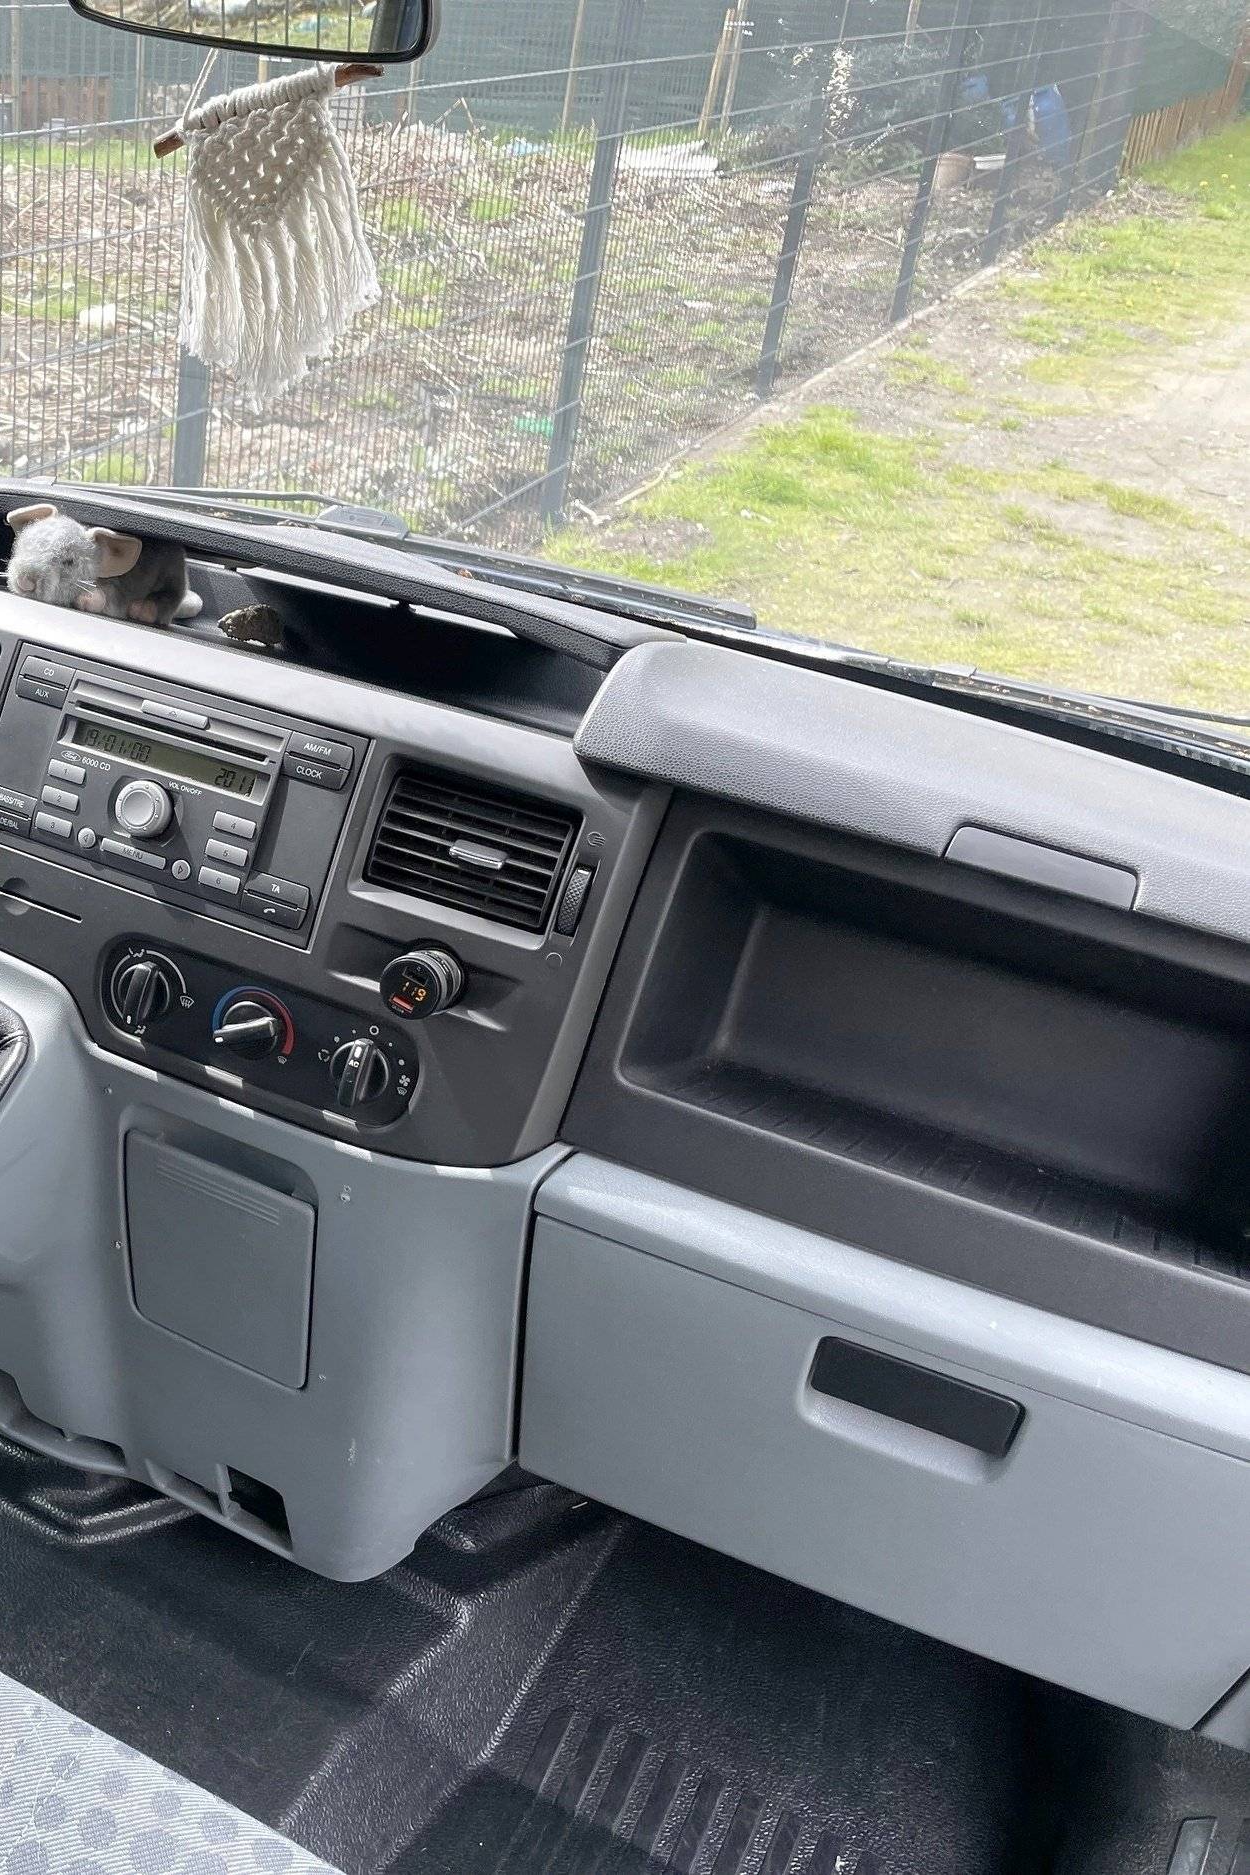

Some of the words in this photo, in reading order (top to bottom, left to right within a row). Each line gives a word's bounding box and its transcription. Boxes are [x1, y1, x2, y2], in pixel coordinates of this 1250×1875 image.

[43, 667, 55, 677] CD
[34, 688, 50, 698] AUX
[303, 742, 332, 756] AM/FM
[81, 756, 99, 768] 6000
[99, 761, 111, 771] CD
[296, 765, 323, 779] CLOCK
[168, 780, 180, 790] VOL
[123, 847, 144, 860] MENU
[222, 849, 229, 857] 5
[216, 877, 222, 885] 6
[271, 883, 281, 894] TA
[348, 1059, 360, 1068] AC
